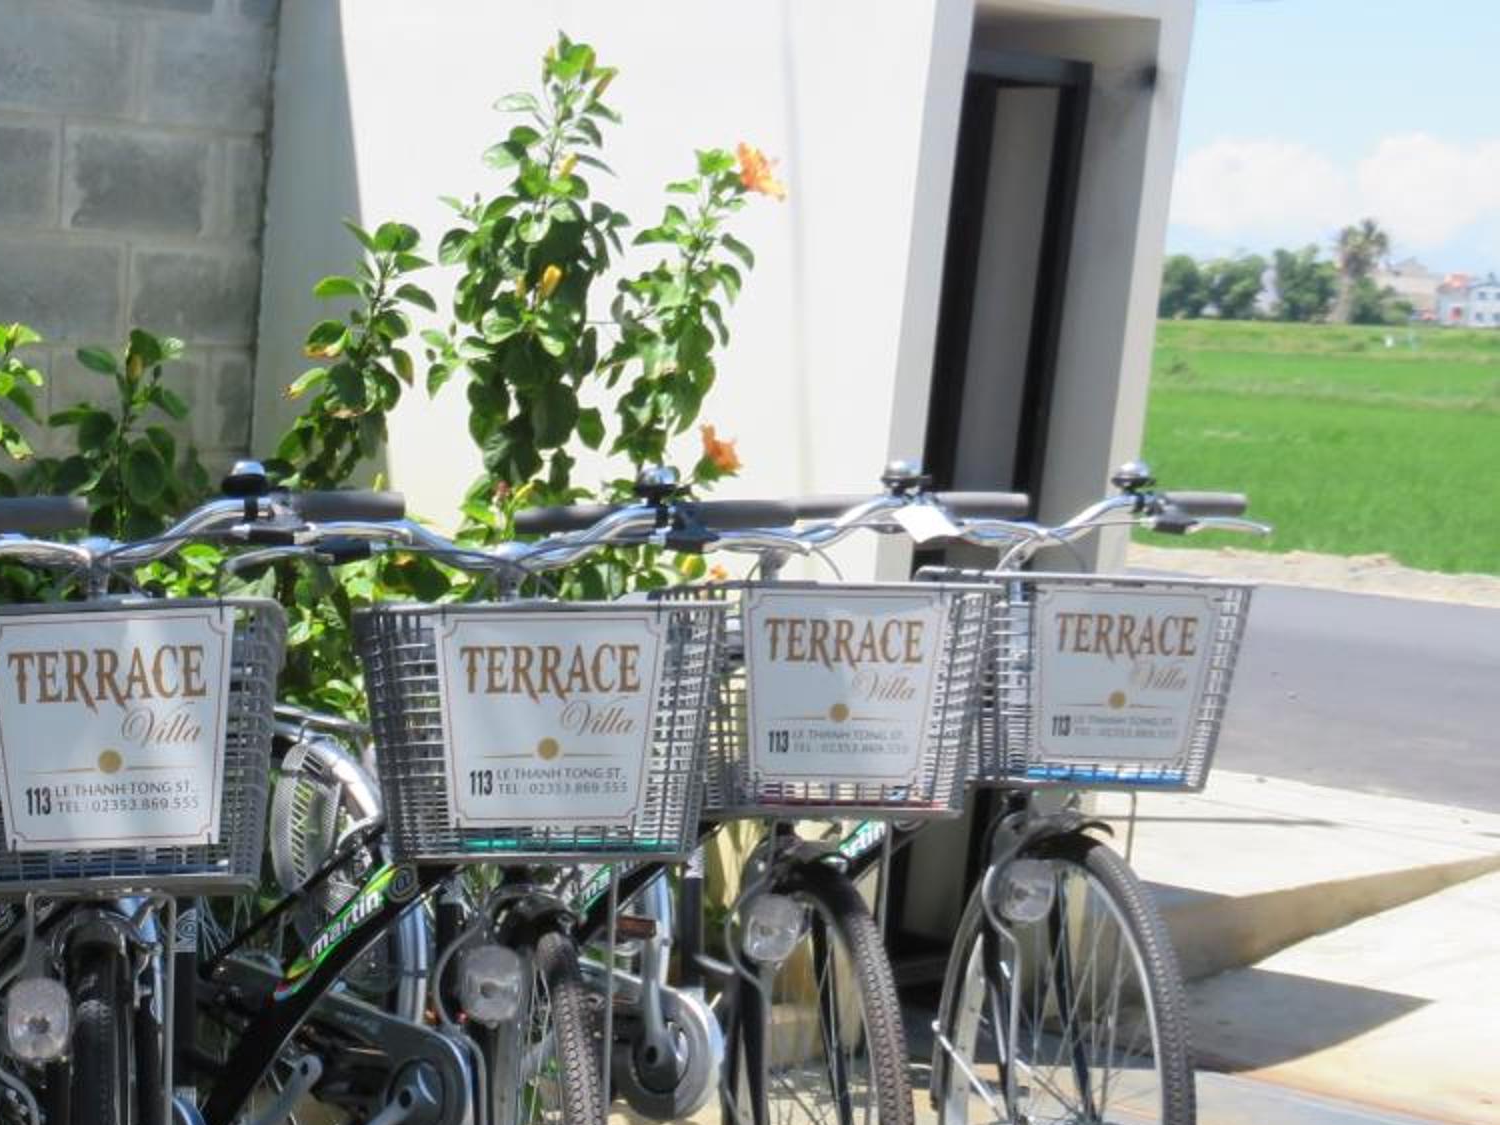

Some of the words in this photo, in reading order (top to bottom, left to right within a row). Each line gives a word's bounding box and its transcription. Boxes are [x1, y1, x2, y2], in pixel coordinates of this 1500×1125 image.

[764, 618, 924, 672] TERRACE
[1056, 613, 1199, 661] TERRACE
[8, 644, 207, 715] TERRACE
[460, 643, 641, 705] TERRACE
[852, 673, 916, 702] Villa
[122, 701, 201, 748] Villa
[560, 696, 635, 736] Villa
[768, 730, 789, 753] 113
[26, 786, 51, 816] 113
[55, 786, 69, 797] LE
[75, 783, 127, 796] THANH
[131, 781, 172, 794] TONG
[470, 769, 493, 796] 113
[565, 767, 605, 779] TONG
[310, 890, 380, 960] martin
